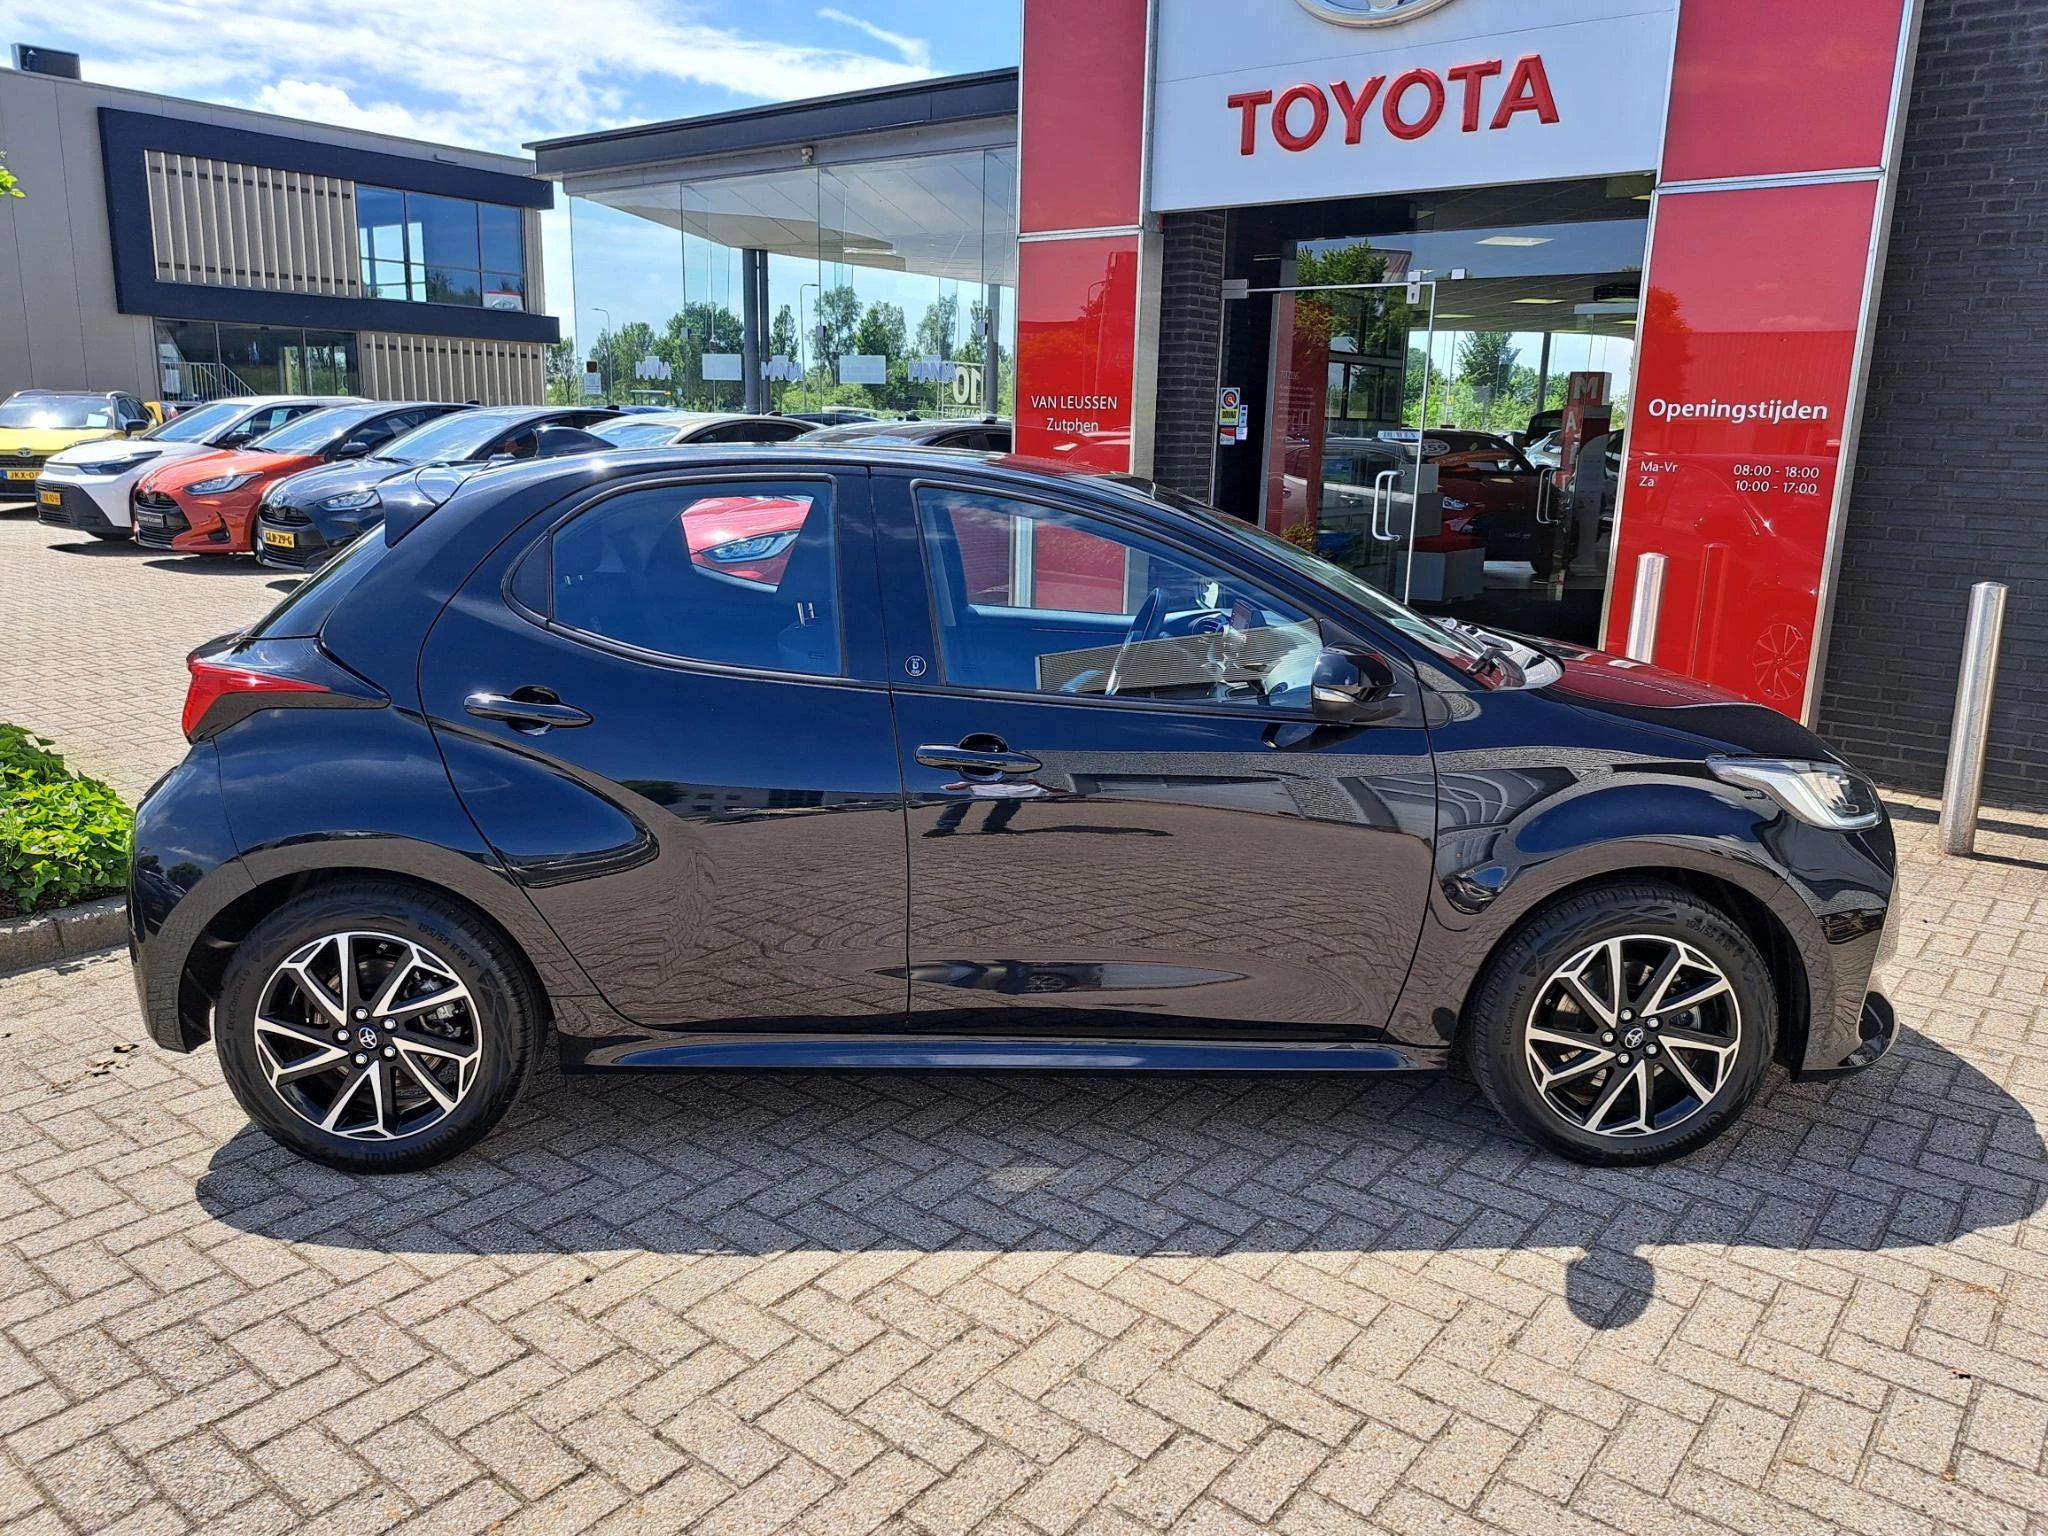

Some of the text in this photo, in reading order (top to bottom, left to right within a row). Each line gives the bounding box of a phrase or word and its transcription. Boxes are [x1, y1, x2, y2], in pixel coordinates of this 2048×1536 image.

[1227, 54, 1560, 155] TOYOTA
[1031, 395, 1118, 410] VAN LEUSSEN
[1648, 399, 1828, 424] Openingstijden
[1046, 417, 1099, 435] Zutphen
[1640, 461, 1679, 473] Ma-Vr
[1733, 464, 1772, 477] 08:00
[1785, 466, 1820, 479] 18:00
[1639, 476, 1655, 487] Za
[1735, 480, 1770, 492] 10:00
[1783, 482, 1818, 495] 17:00
[1503, 984, 1526, 1045] EcoContact 6
